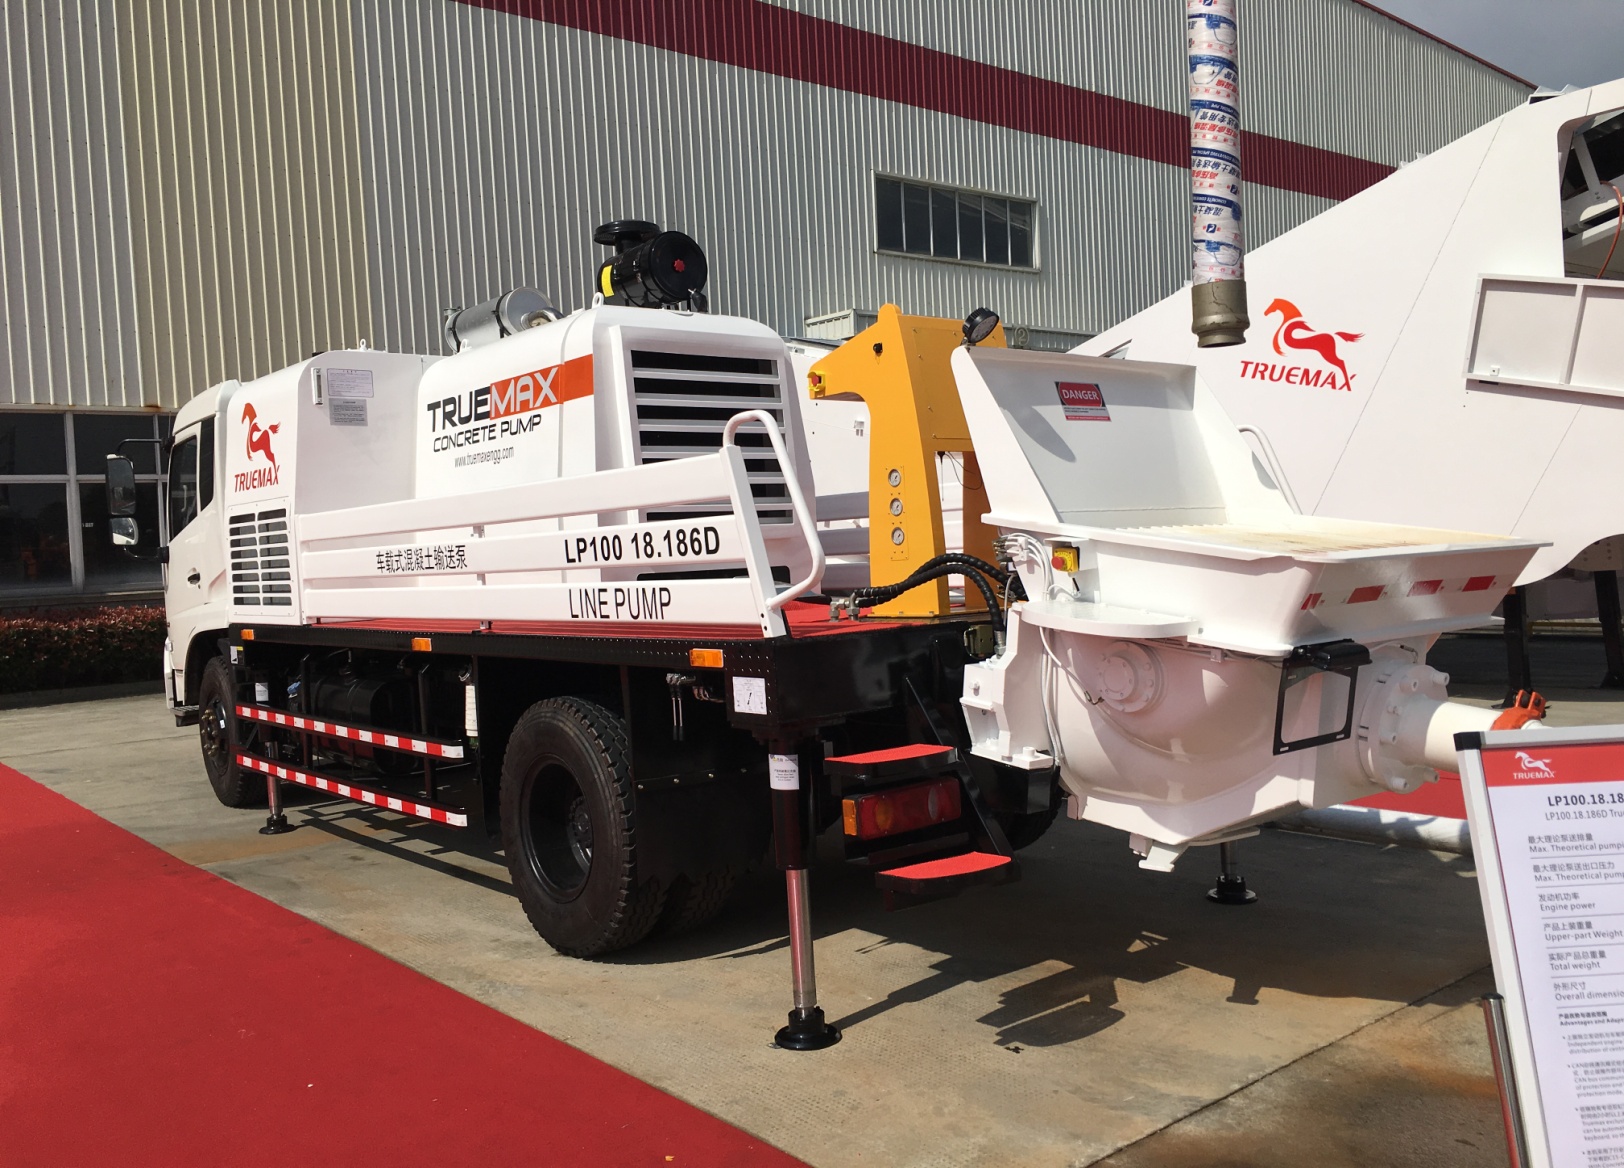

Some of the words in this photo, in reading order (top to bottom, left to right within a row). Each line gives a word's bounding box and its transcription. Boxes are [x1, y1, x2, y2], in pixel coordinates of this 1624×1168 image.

[1240, 360, 1357, 391] TRUEMAX
[427, 366, 559, 432] TRUEMAX
[1062, 389, 1100, 400] DANGER
[433, 423, 496, 453] CONCRETE
[500, 413, 542, 438] PUMP
[454, 446, 515, 468] www.truemaxengg.com
[234, 464, 280, 493] TRUEMAX
[564, 534, 623, 564] LP100
[630, 526, 720, 559] 18.186D
[376, 545, 468, 573] 车载式混凝土输送泵
[568, 587, 610, 619] LINE
[614, 587, 672, 620] PUMP
[1513, 770, 1555, 780] TRUEMAX
[1547, 792, 1624, 807] LP100.18.18
[1545, 809, 1608, 820] LP100.18.186D
[1528, 833, 1594, 844] 最大理论泵送排量
[1529, 845, 1549, 853] Max.
[1551, 843, 1597, 852] Theoretical
[1533, 861, 1615, 873] 最大理论泵送出口压力
[1534, 874, 1555, 882] Max.
[1555, 872, 1602, 881] Theoretical
[1538, 892, 1580, 902] 发动机功率
[1540, 903, 1568, 913] Engine
[1570, 902, 1596, 911] power
[1544, 921, 1593, 932] 产品上装重量
[1544, 931, 1592, 942] Upper-part
[1592, 930, 1623, 940] Weight
[1548, 950, 1607, 961] 实际产品总重量
[1550, 962, 1570, 971] Total
[1571, 961, 1601, 971] weight
[1553, 981, 1586, 991] 外形尺寸
[1555, 991, 1585, 1001] Overall
